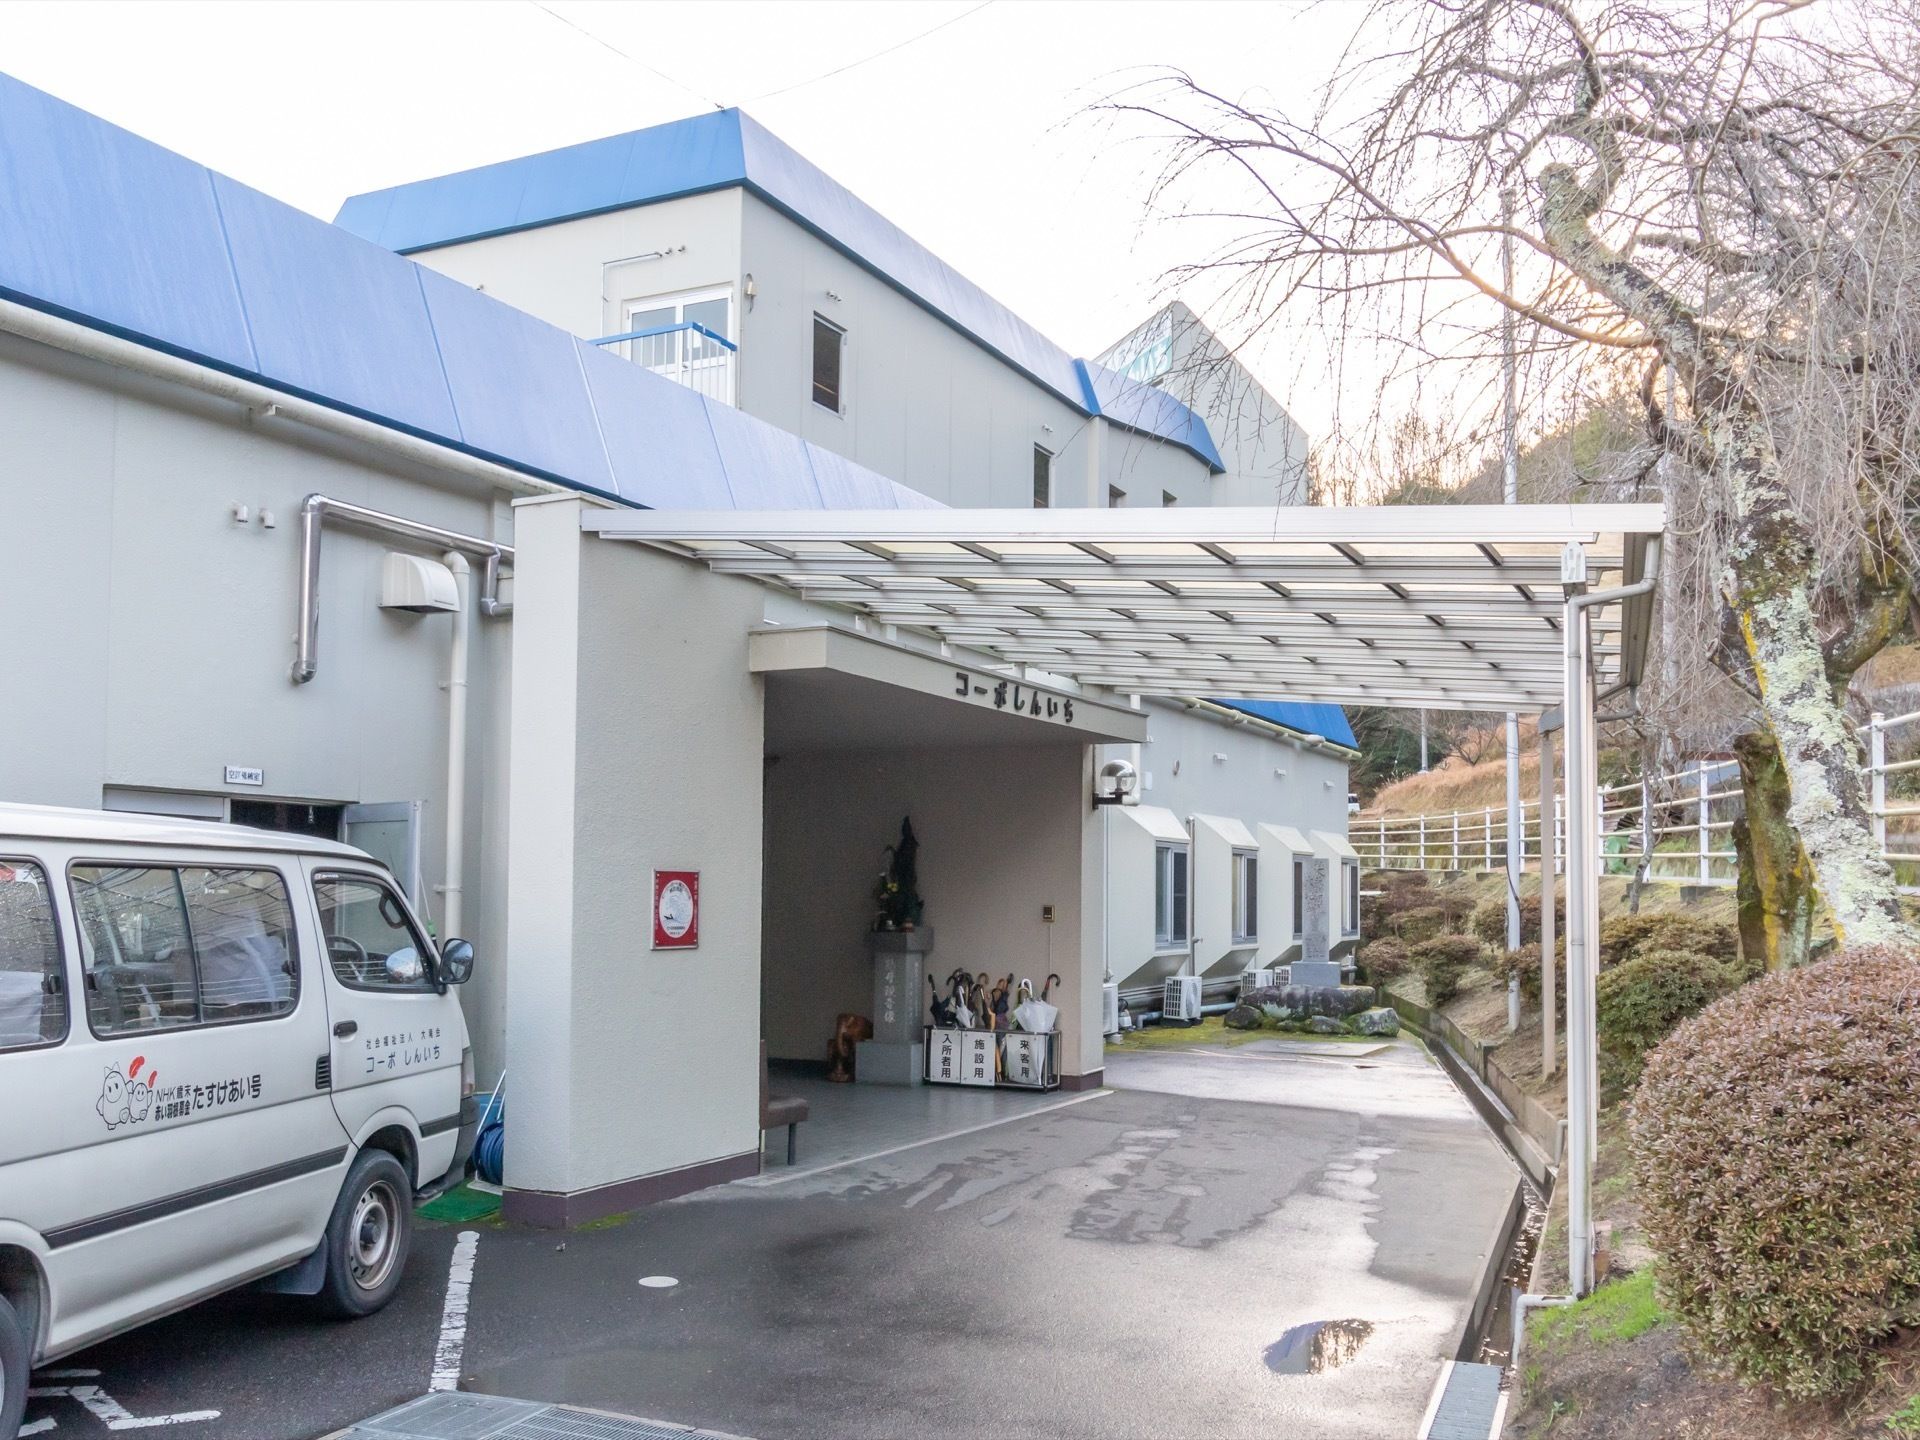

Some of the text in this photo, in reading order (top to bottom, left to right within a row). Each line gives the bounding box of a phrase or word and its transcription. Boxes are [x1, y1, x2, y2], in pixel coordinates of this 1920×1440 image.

[956, 672, 1073, 723] コーポしんいち
[366, 1044, 440, 1073] コーポ しんいち
[941, 1033, 952, 1079] 入所者用
[974, 1039, 985, 1079] 施設用
[1020, 1040, 1030, 1079] 来客用
[155, 1100, 191, 1122] 赤い羽根募金
[192, 1074, 262, 1110] たすけあい号
